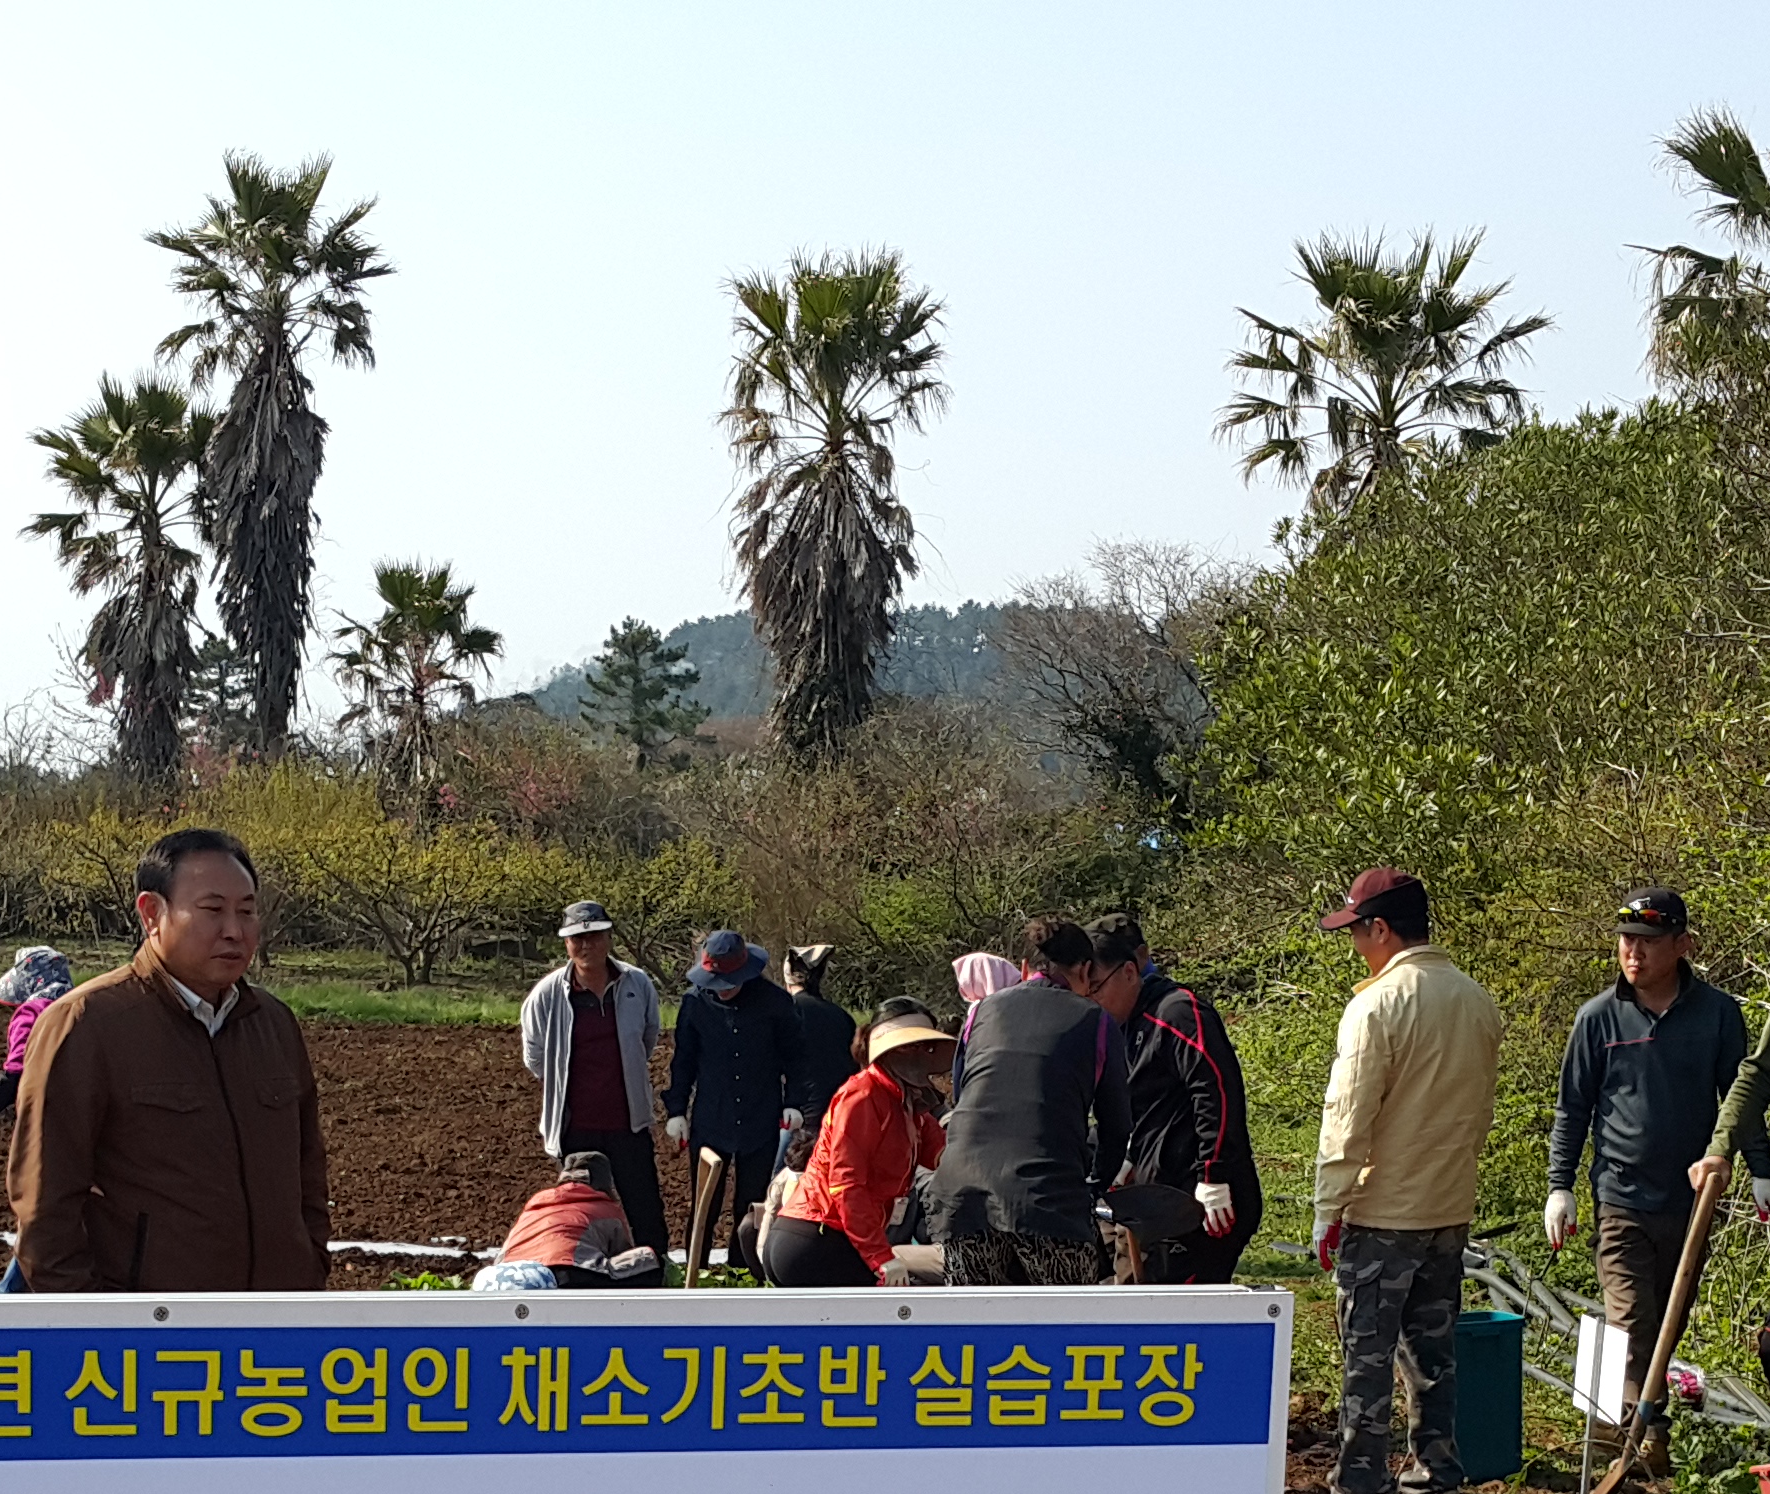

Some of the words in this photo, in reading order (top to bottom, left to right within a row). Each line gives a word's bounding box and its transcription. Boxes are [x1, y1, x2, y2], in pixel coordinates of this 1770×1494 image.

[64, 1347, 469, 1437] 신규농업인
[498, 1345, 886, 1432] 채소기초반
[909, 1343, 1204, 1427] 실습포장
